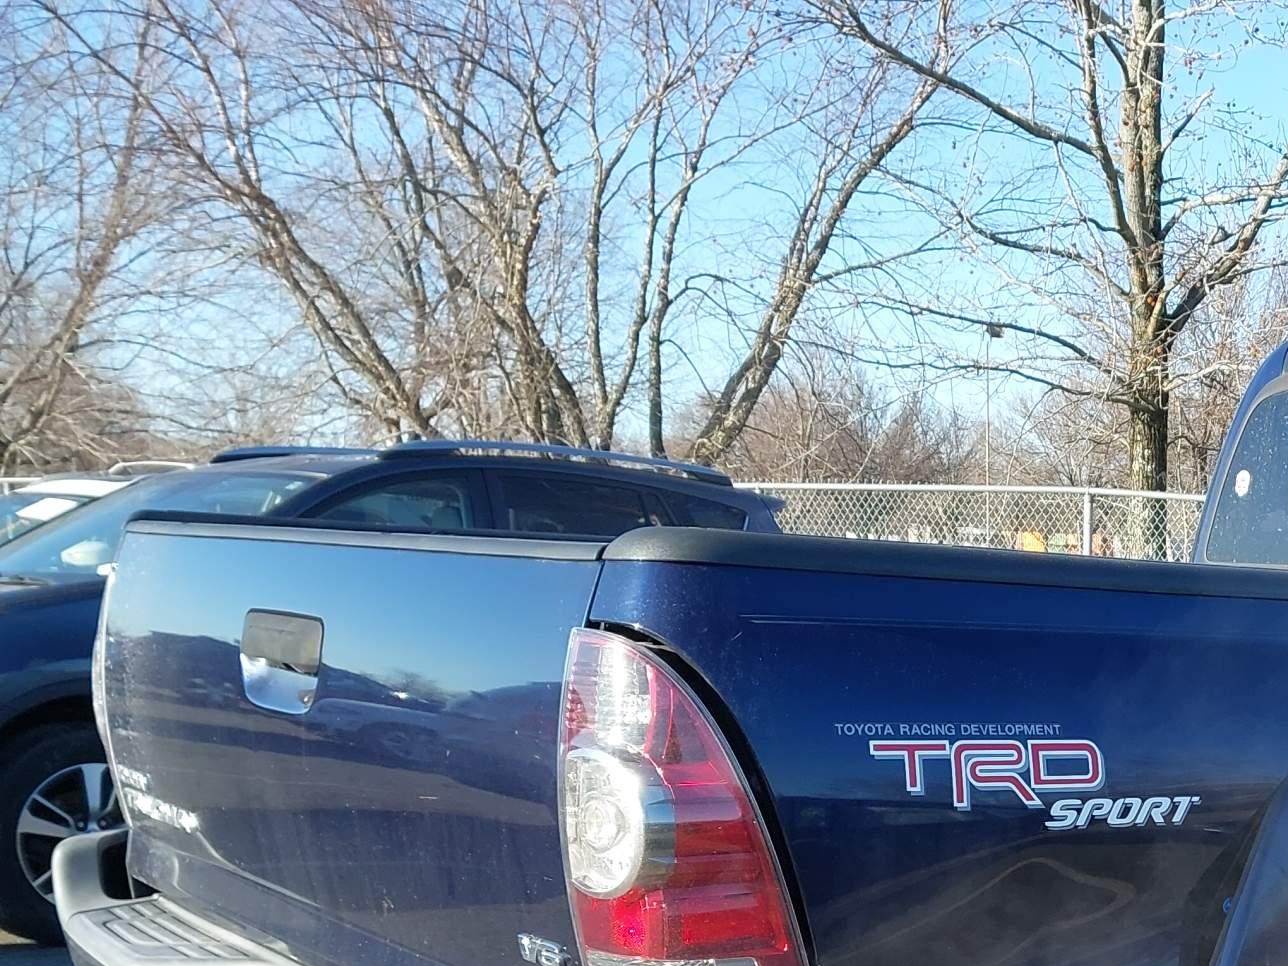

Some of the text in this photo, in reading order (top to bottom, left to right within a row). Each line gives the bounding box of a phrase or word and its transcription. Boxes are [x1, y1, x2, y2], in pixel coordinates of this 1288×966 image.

[835, 723, 1061, 736] TOYOTA RACING DEVELOPMENT
[868, 739, 1105, 812] TRD
[1044, 795, 1201, 830] SPORT
